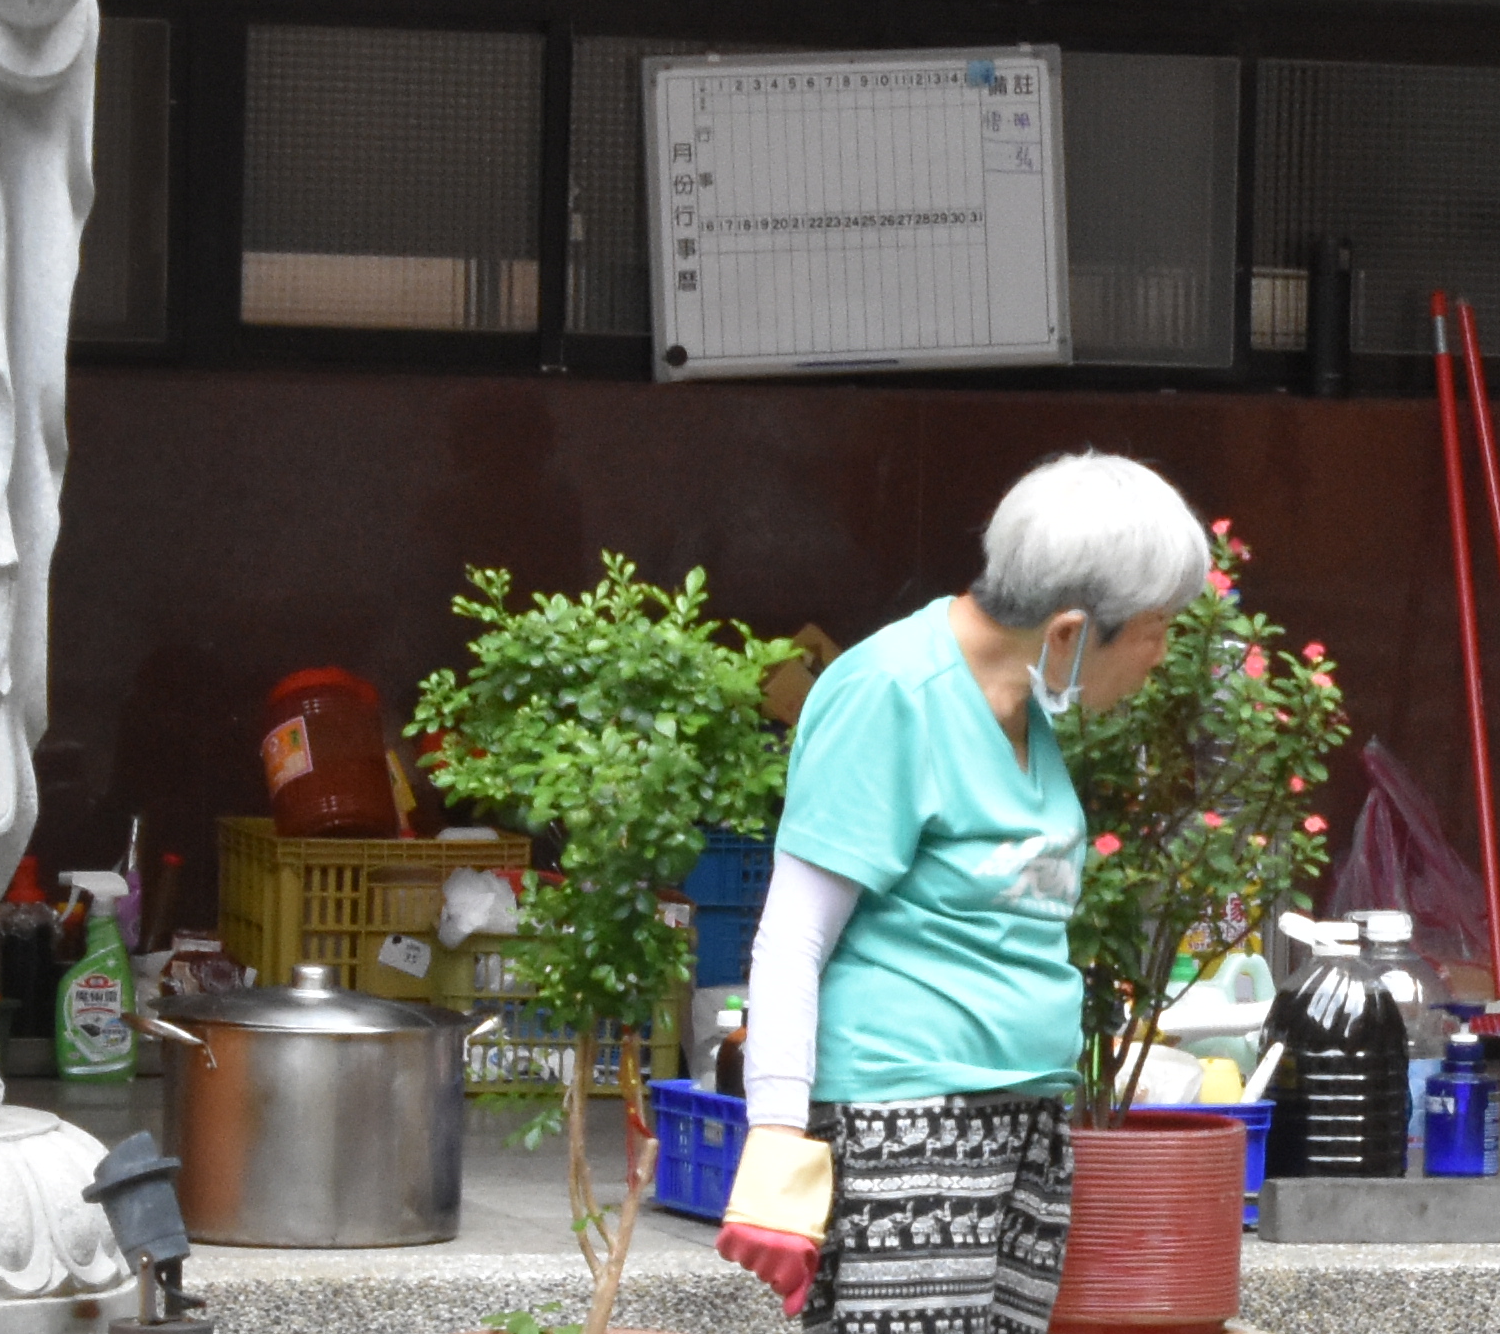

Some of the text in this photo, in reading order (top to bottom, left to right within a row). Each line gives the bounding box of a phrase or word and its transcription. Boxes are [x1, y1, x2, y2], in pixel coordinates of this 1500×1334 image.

[735, 80, 743, 91] 2
[754, 79, 762, 91] 3
[771, 79, 778, 89] 4
[788, 77, 797, 89] 5
[806, 77, 815, 88] 6
[825, 77, 832, 87] 7
[843, 75, 851, 87] 8
[860, 75, 868, 87] 9
[875, 74, 889, 86] 10
[895, 75, 905, 85] 11
[910, 73, 923, 85] 12
[927, 73, 941, 84] 13
[946, 73, 958, 83] 14
[701, 212, 983, 231] 16 17 18 19 20 21 22 23 24 25 26 27 28 29 30 31
